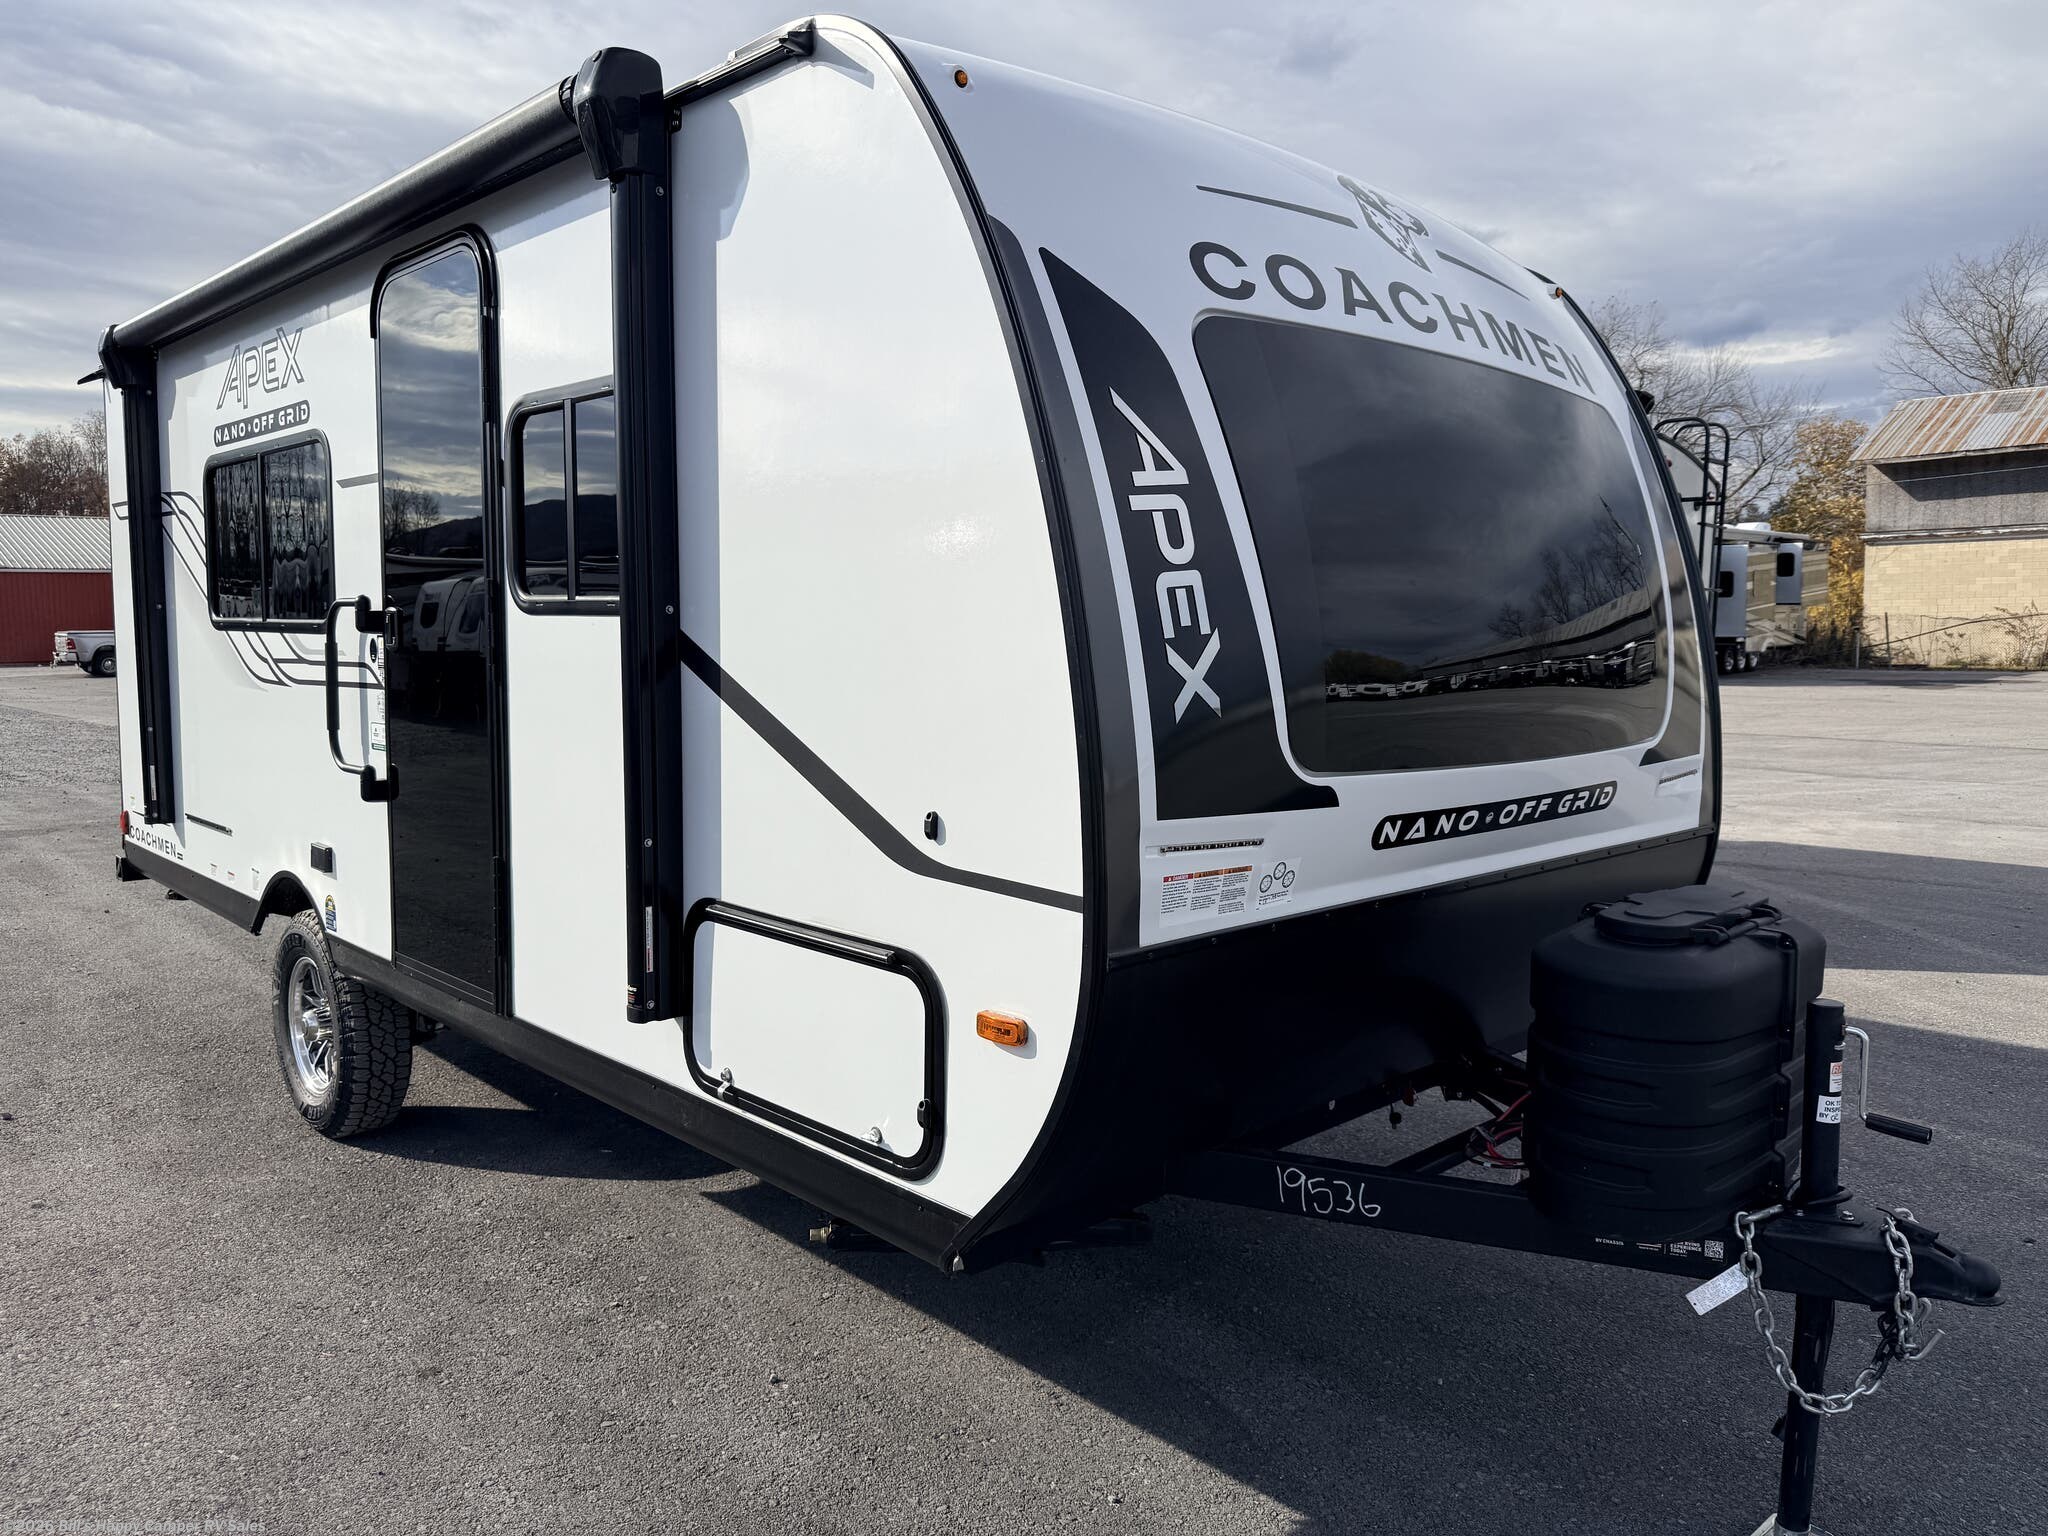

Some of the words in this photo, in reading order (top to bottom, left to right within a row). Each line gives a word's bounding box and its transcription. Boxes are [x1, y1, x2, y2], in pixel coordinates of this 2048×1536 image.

[1188, 241, 1597, 395] COACHMEN
[216, 326, 305, 410] APEX
[214, 423, 247, 444] NANO
[253, 413, 275, 434] OFF
[278, 403, 309, 426] GRID
[1108, 386, 1222, 725] APEX
[129, 824, 177, 858] COACHMEN
[1378, 809, 1480, 844] NANO
[1498, 797, 1552, 825] OFF
[1557, 785, 1614, 814] GRID
[1276, 1165, 1382, 1218] 19536
